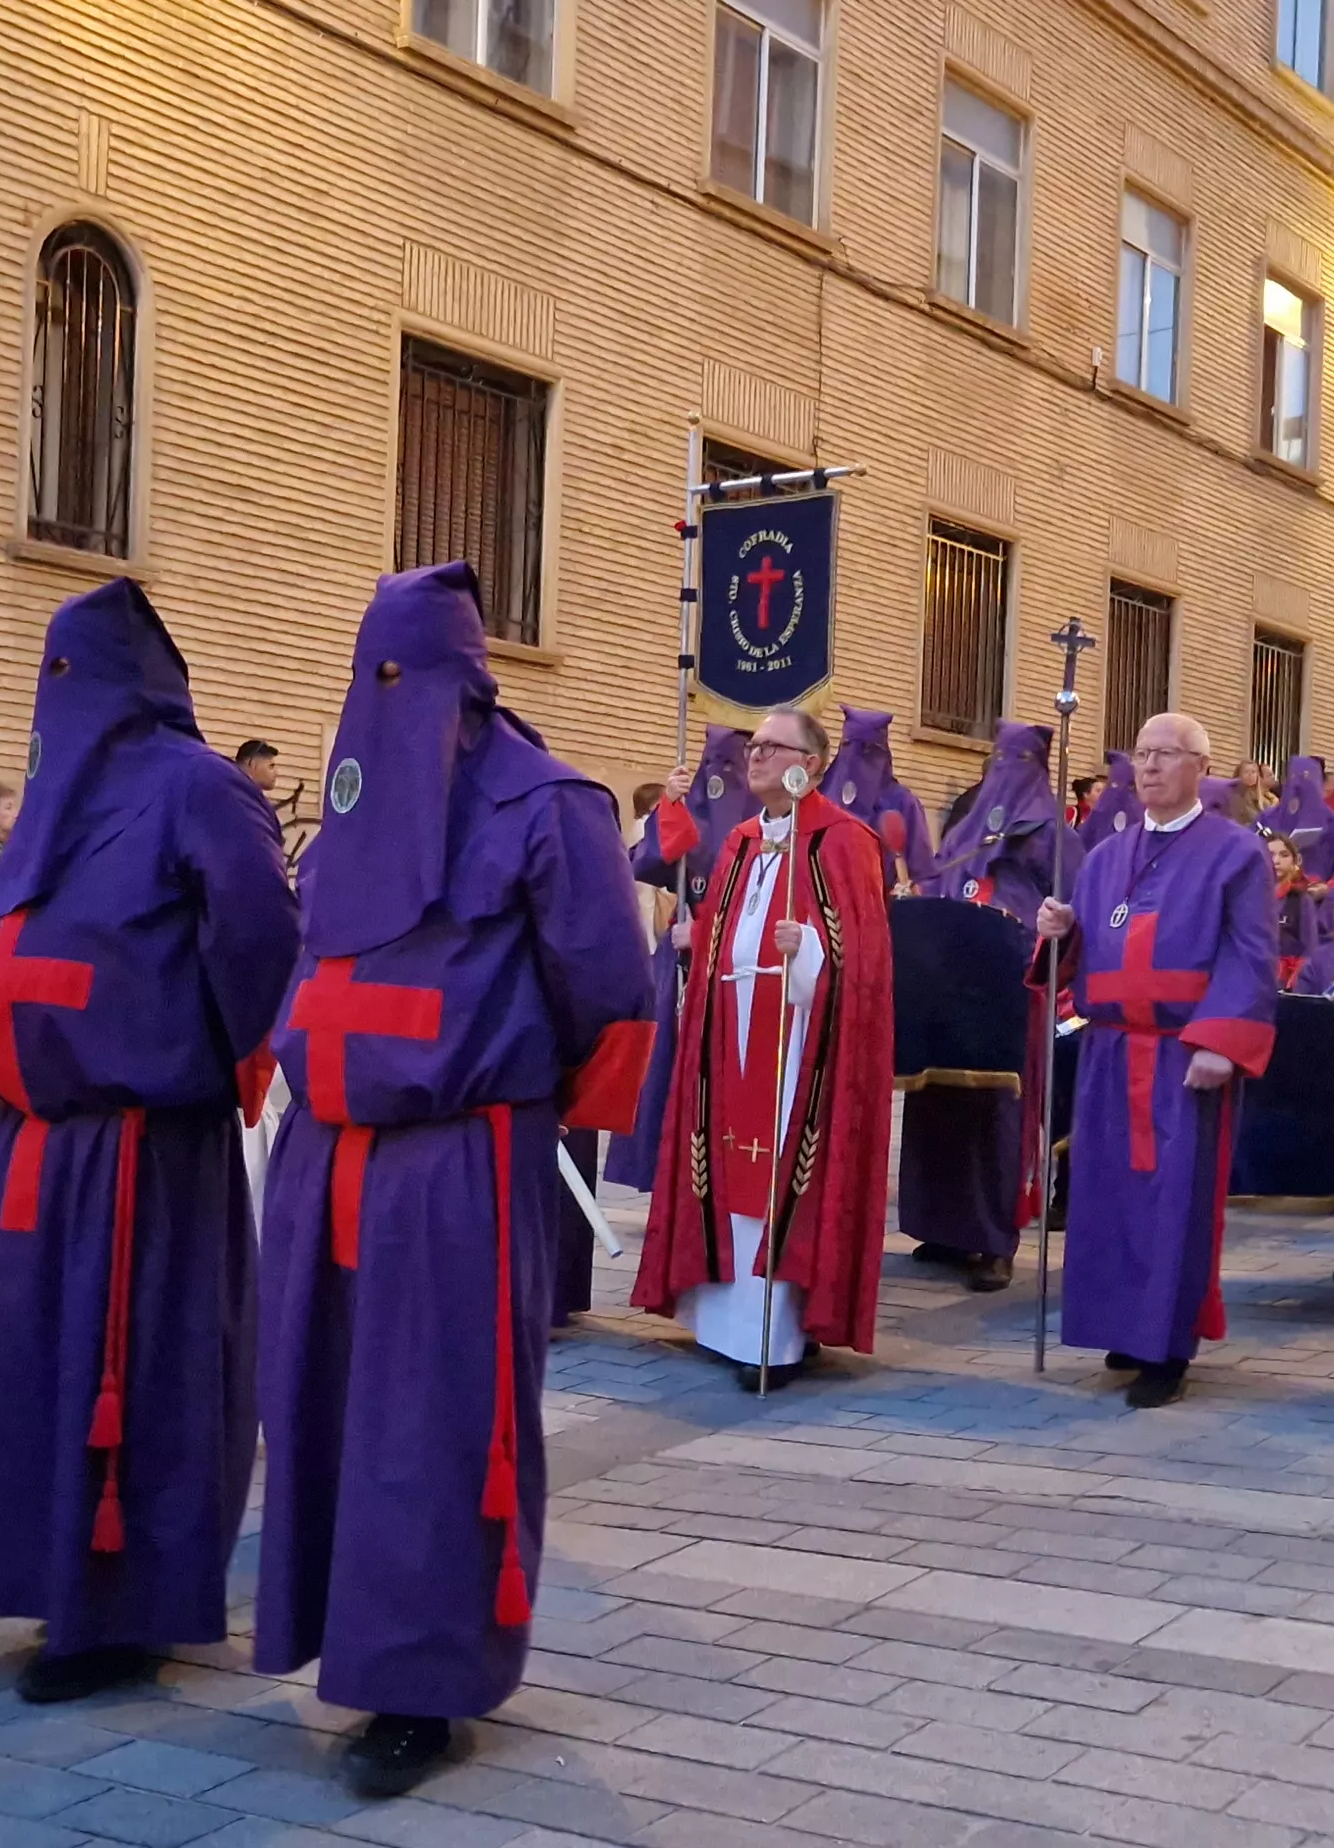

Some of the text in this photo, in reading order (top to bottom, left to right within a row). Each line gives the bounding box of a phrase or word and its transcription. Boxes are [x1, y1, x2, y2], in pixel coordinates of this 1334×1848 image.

[739, 529, 793, 558] COFRADIA
[748, 645, 763, 658] DE
[763, 643, 779, 657] LA
[767, 655, 792, 672] 2011
